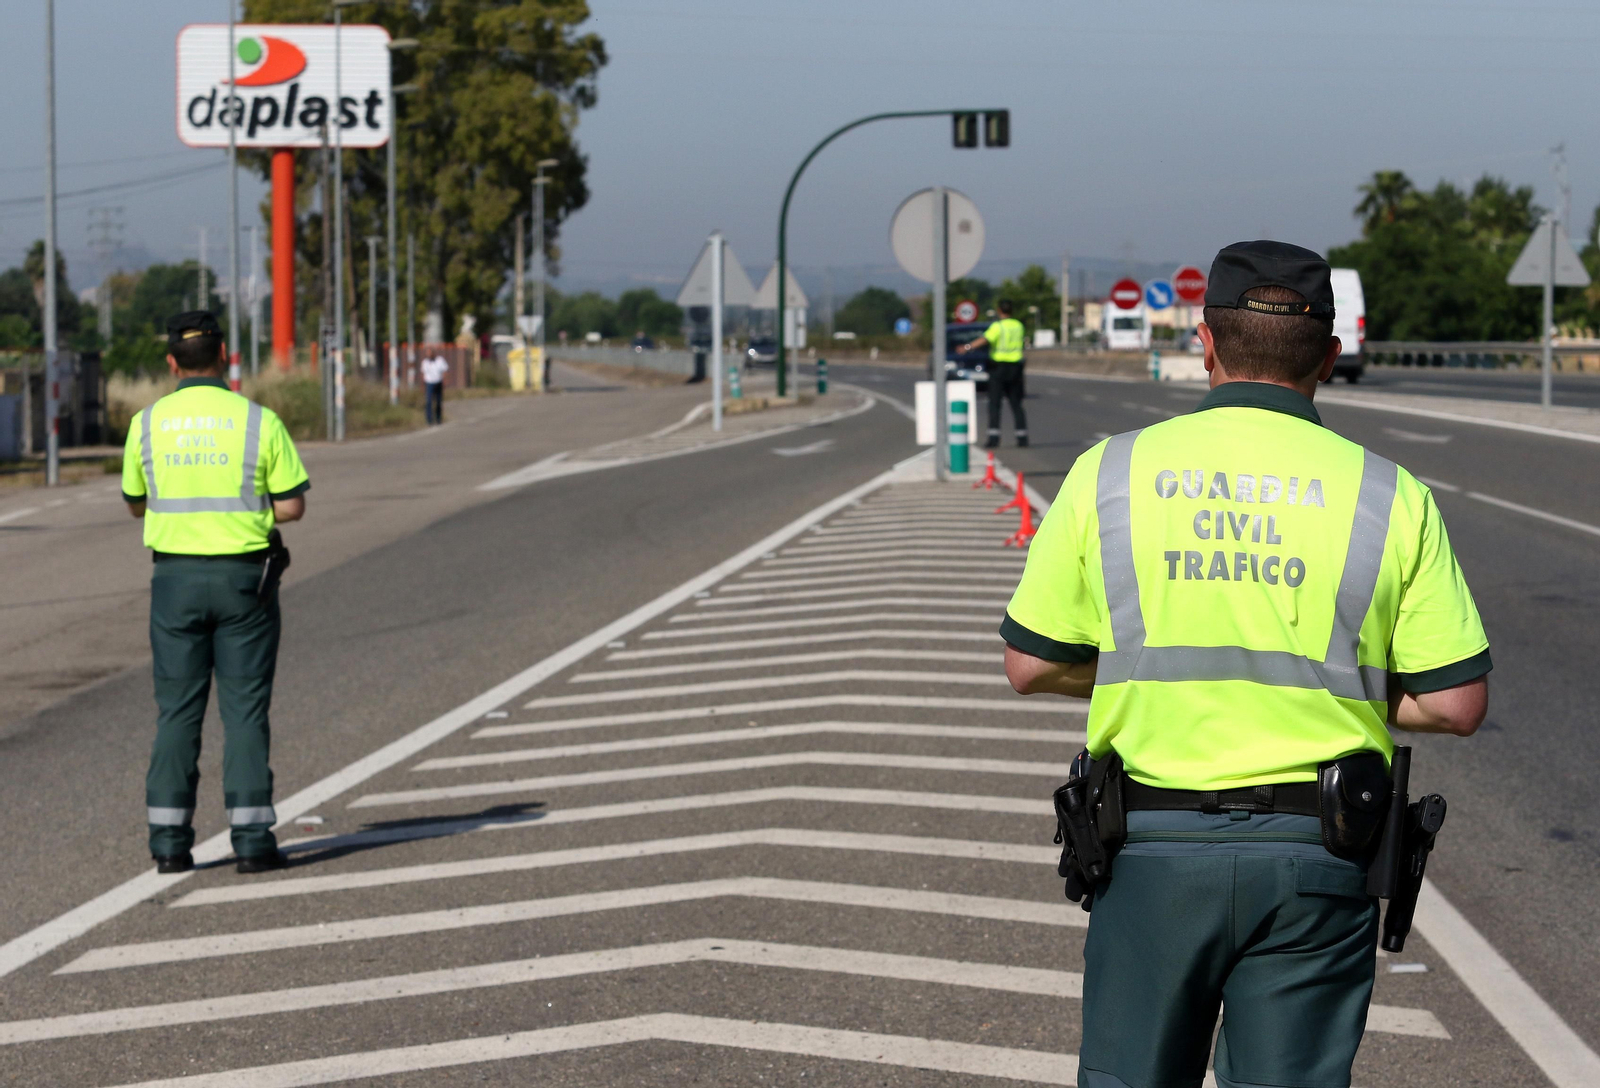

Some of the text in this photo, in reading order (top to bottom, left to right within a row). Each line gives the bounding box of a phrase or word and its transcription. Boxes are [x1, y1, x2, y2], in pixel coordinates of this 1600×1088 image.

[187, 82, 384, 139] daplast
[1247, 299, 1290, 313] GUARDIA CIVIL
[161, 416, 234, 431] GUARDIA
[176, 434, 216, 448] CIVIL
[165, 453, 229, 466] TRAFICO
[1155, 469, 1326, 508] GUARDIA
[1193, 509, 1282, 545] CIVIL
[1164, 550, 1306, 588] TRAFICO
